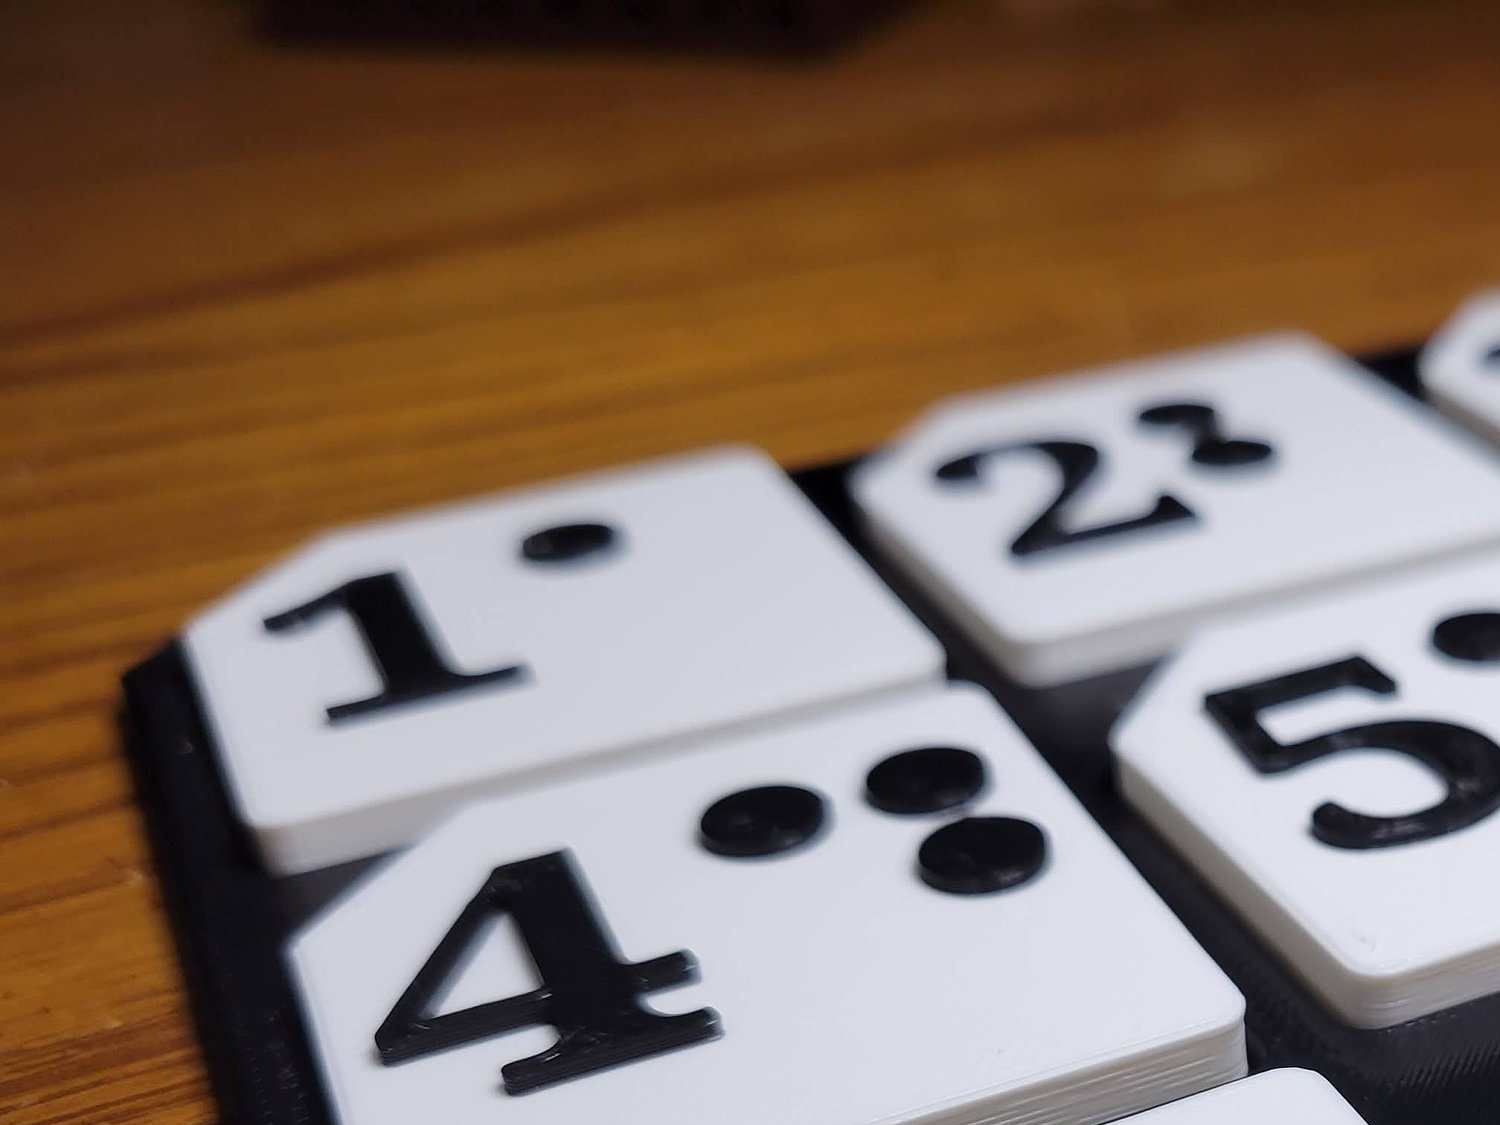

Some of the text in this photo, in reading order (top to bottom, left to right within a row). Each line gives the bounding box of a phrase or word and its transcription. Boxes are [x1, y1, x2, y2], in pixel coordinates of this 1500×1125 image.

[932, 438, 1200, 562] 2
[260, 570, 524, 726] 1
[372, 850, 722, 1098] 4
